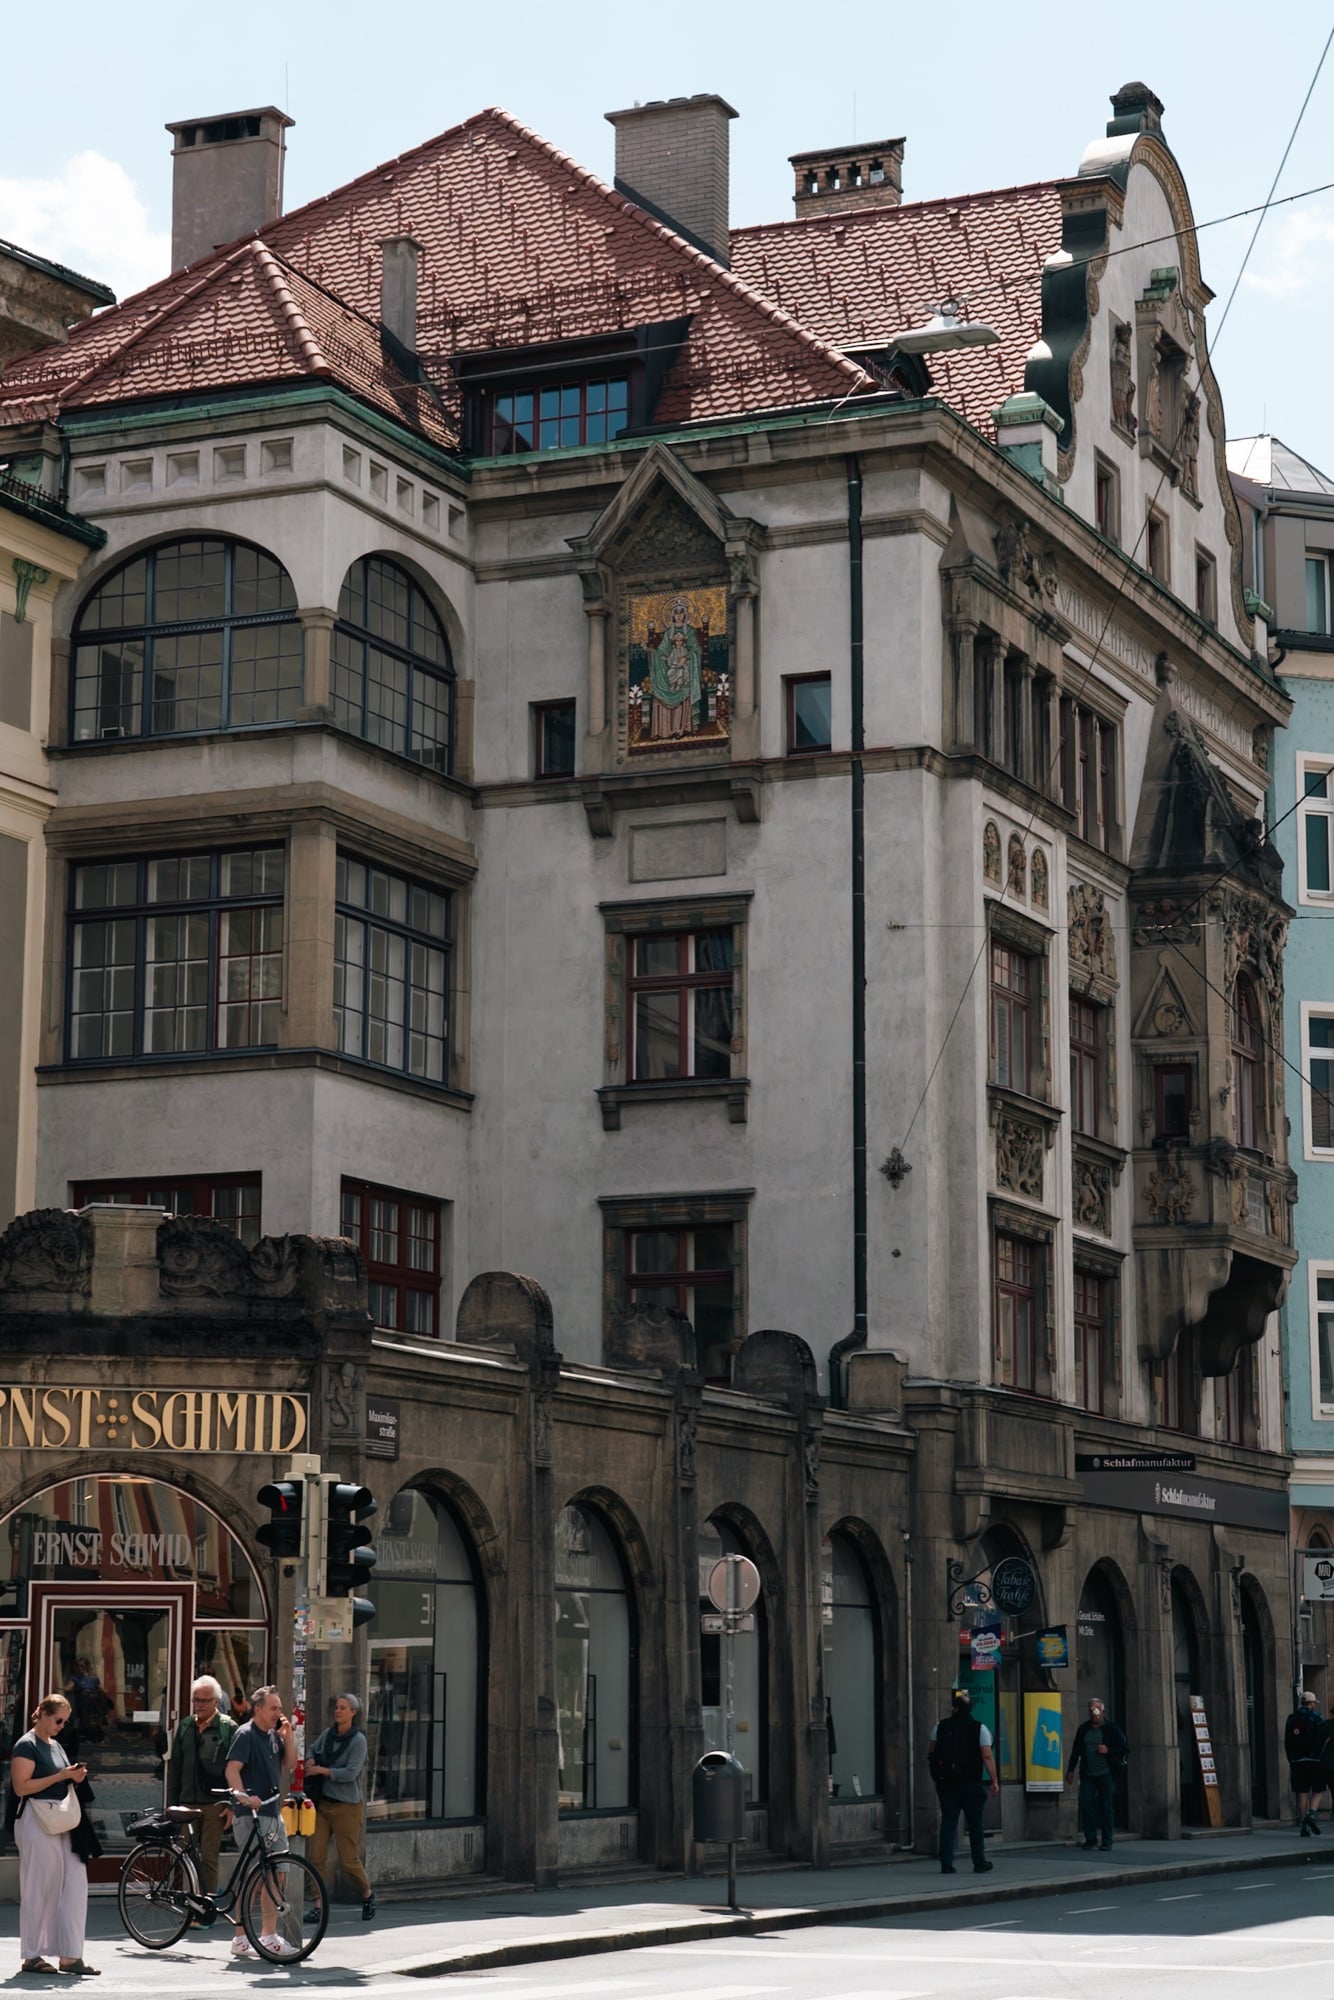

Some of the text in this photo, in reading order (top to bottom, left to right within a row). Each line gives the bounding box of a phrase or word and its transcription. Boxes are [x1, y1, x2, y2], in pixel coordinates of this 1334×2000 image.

[131, 1391, 306, 1452] SCHMID
[1103, 1457, 1192, 1468] Schlafmanufaktur
[1161, 1487, 1215, 1510] Schlafmanufaktur
[33, 1531, 192, 1567] ERNST SCHMID
[999, 1570, 1027, 1585] Tabak
[999, 1586, 1029, 1602] Trafik
